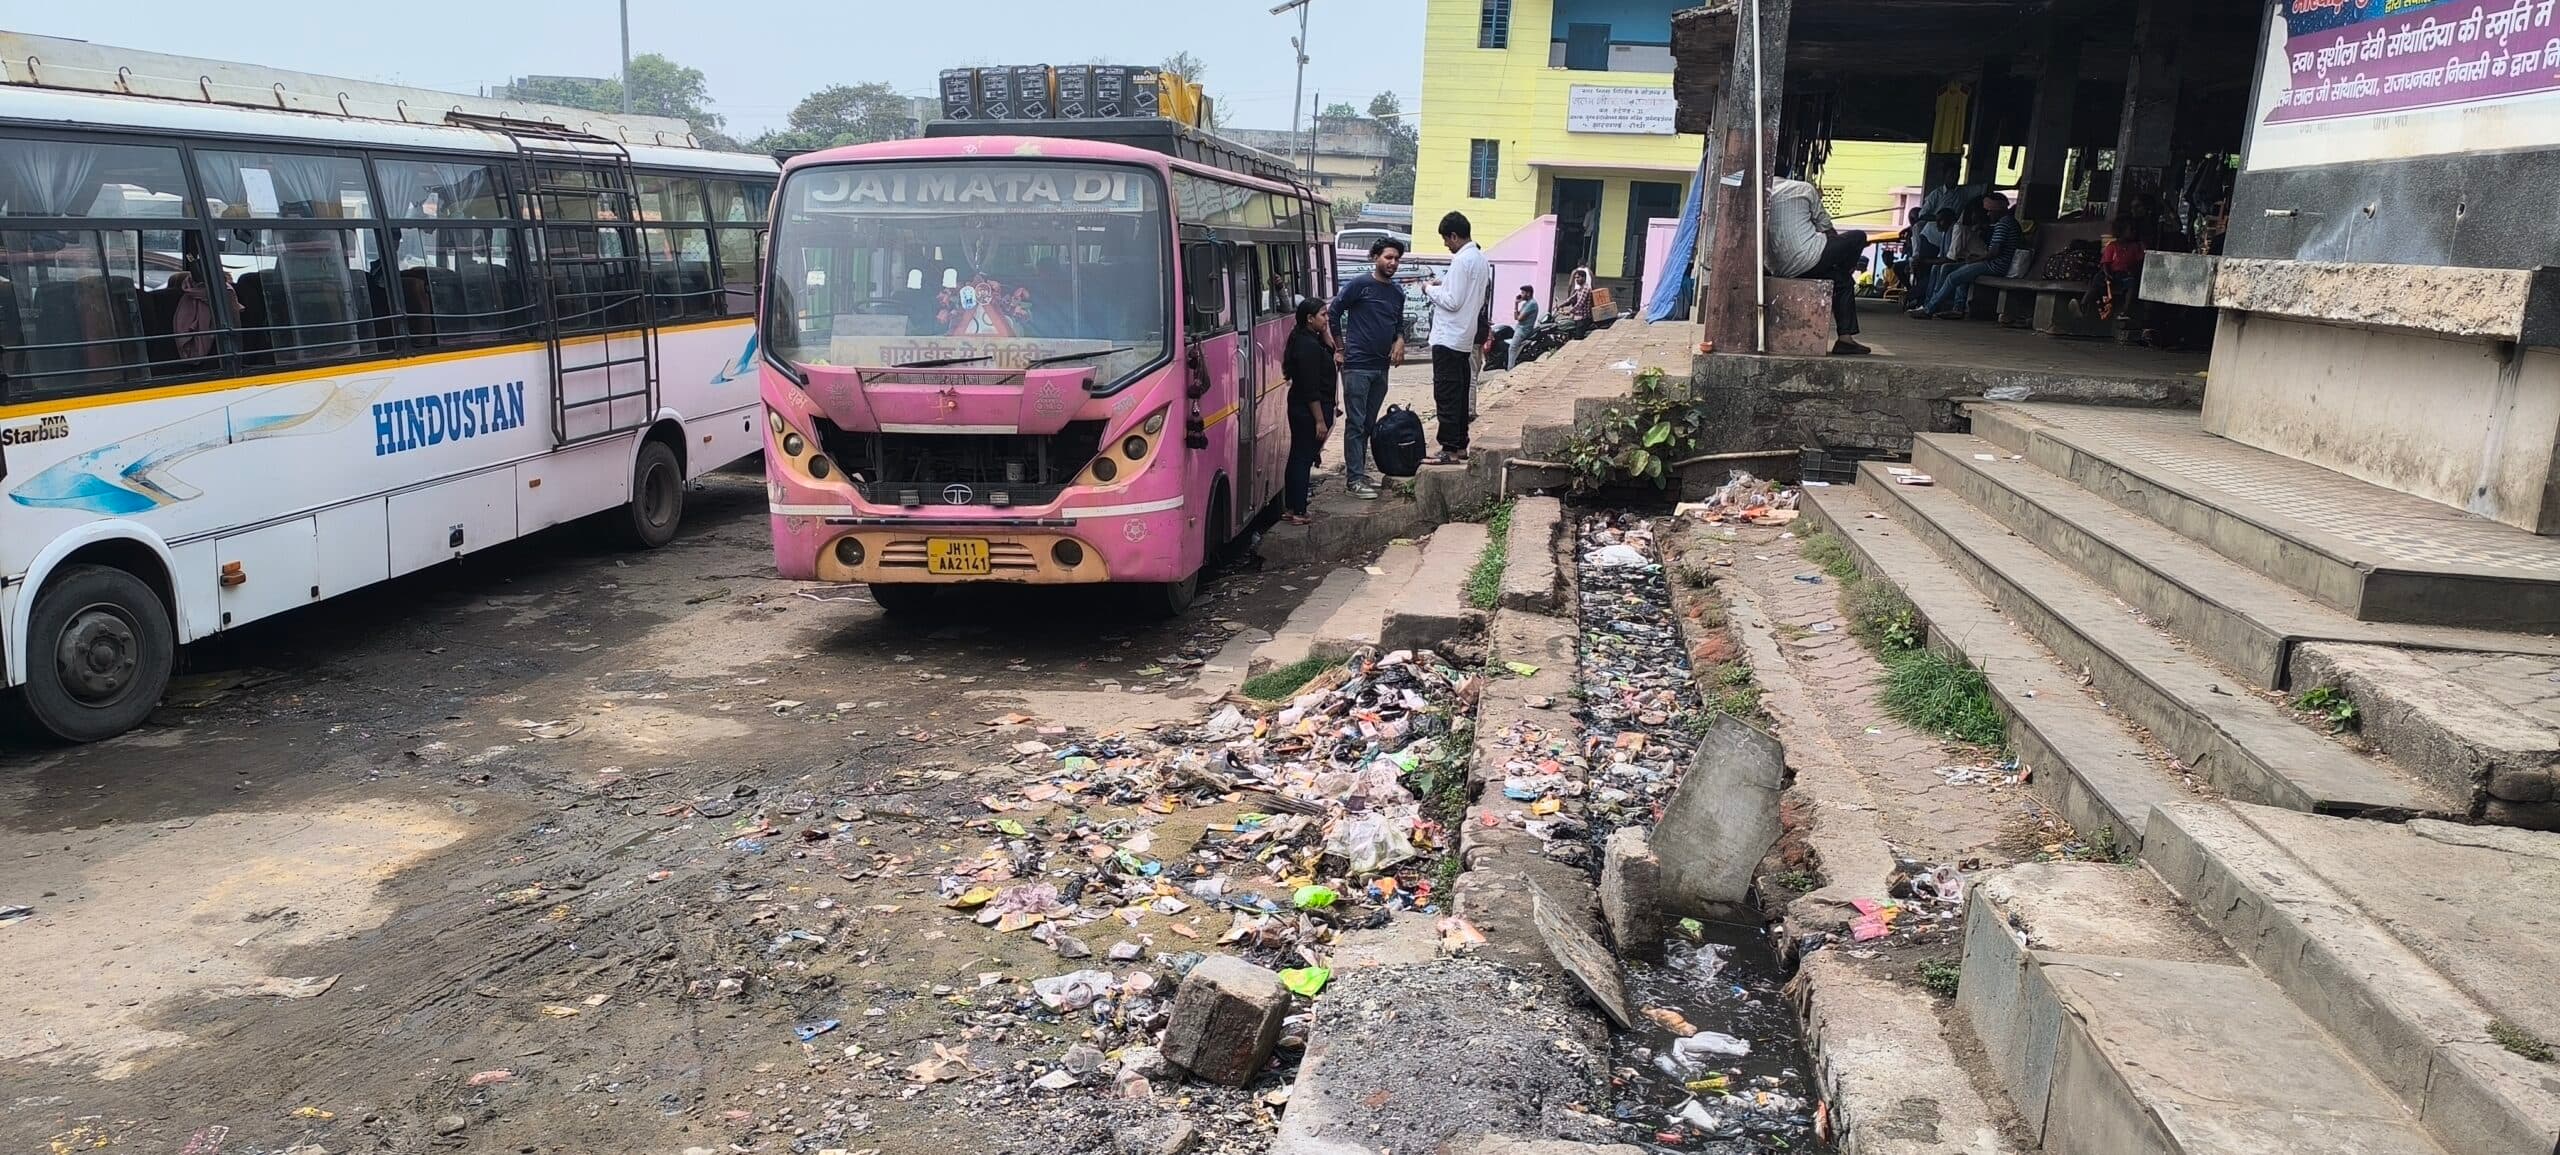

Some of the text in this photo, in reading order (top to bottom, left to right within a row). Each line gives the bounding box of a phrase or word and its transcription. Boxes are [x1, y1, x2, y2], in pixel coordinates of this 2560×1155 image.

[2317, 36, 2359, 79] सुशीला
[2360, 27, 2386, 61] देवी
[2458, 5, 2483, 43] की
[2485, 0, 2533, 47] स्मृति
[2293, 87, 2315, 106] लाल
[2316, 78, 2330, 101] जी
[2445, 51, 2490, 84] निवासी
[2492, 48, 2510, 76] के
[2510, 50, 2541, 77] द्वारा
[811, 174, 1126, 203] JAI MATA DI
[41, 415, 67, 426] TATA
[372, 381, 525, 456] HINDUSTAN
[2, 425, 70, 446] Starbus
[946, 542, 977, 556] JH11
[940, 557, 987, 570] AA2141
